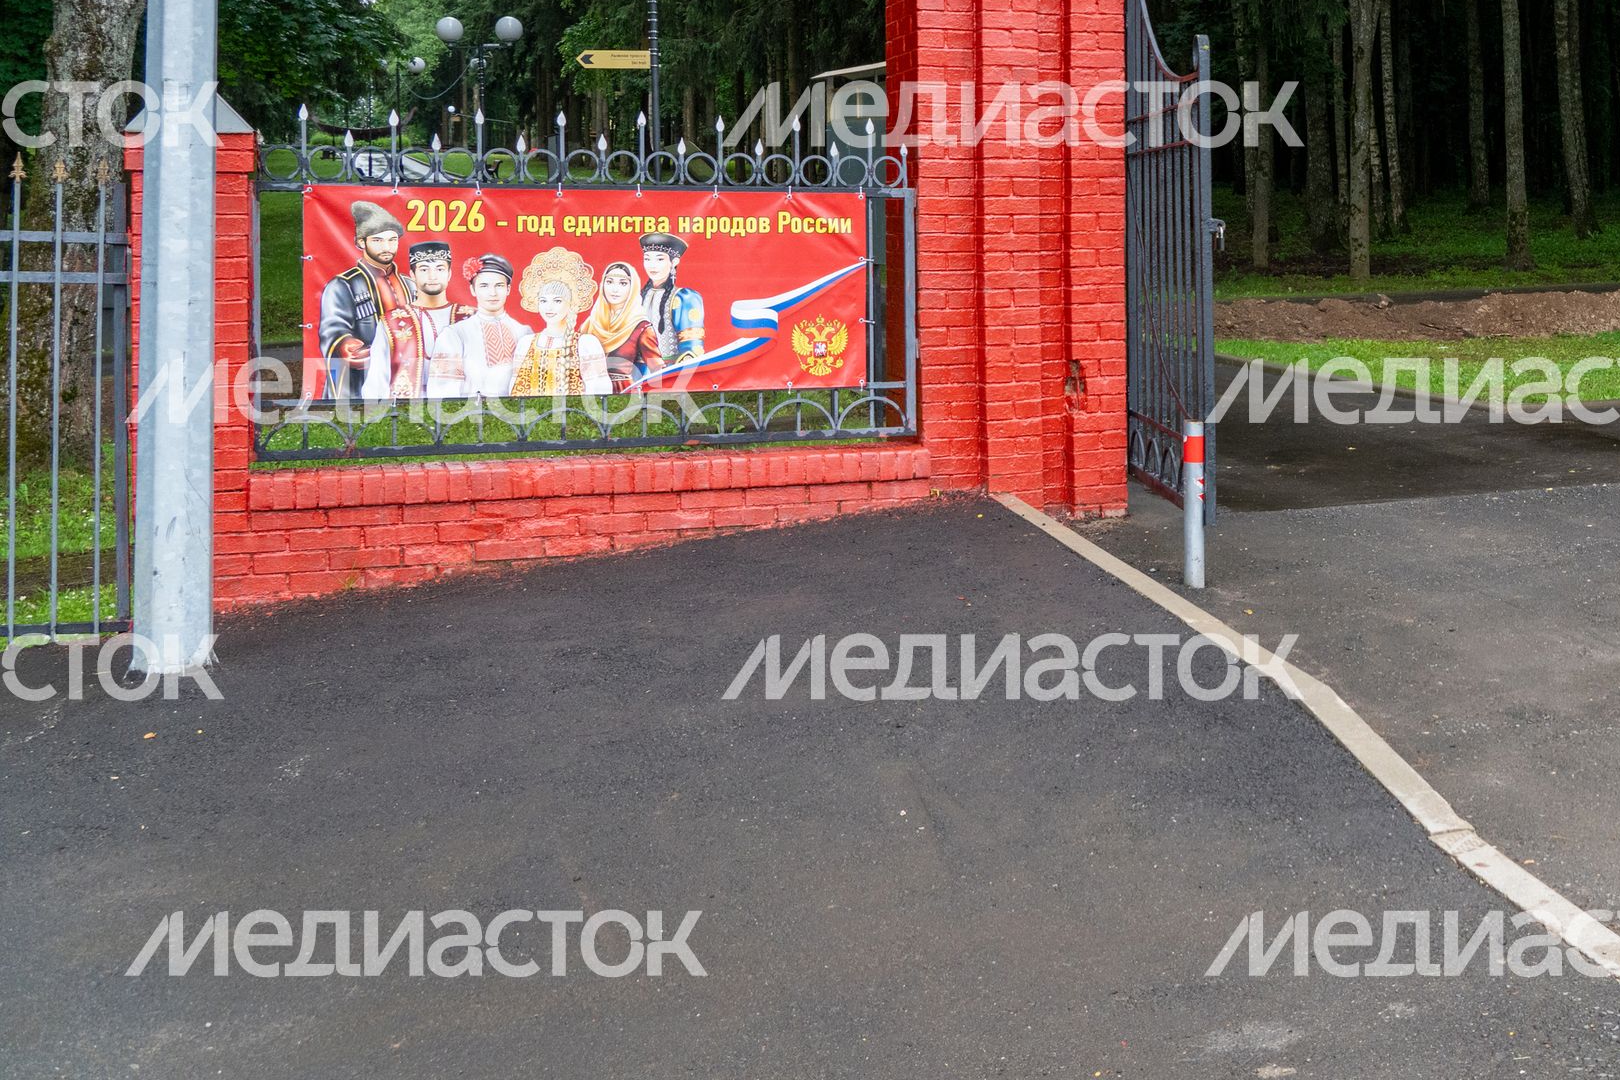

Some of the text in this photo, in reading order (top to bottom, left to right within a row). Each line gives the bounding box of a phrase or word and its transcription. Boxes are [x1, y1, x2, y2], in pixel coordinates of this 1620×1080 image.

[407, 199, 486, 233] 2026
[516, 213, 555, 236] год
[563, 214, 670, 237] единства
[678, 213, 771, 238] народов
[777, 210, 852, 235] России
